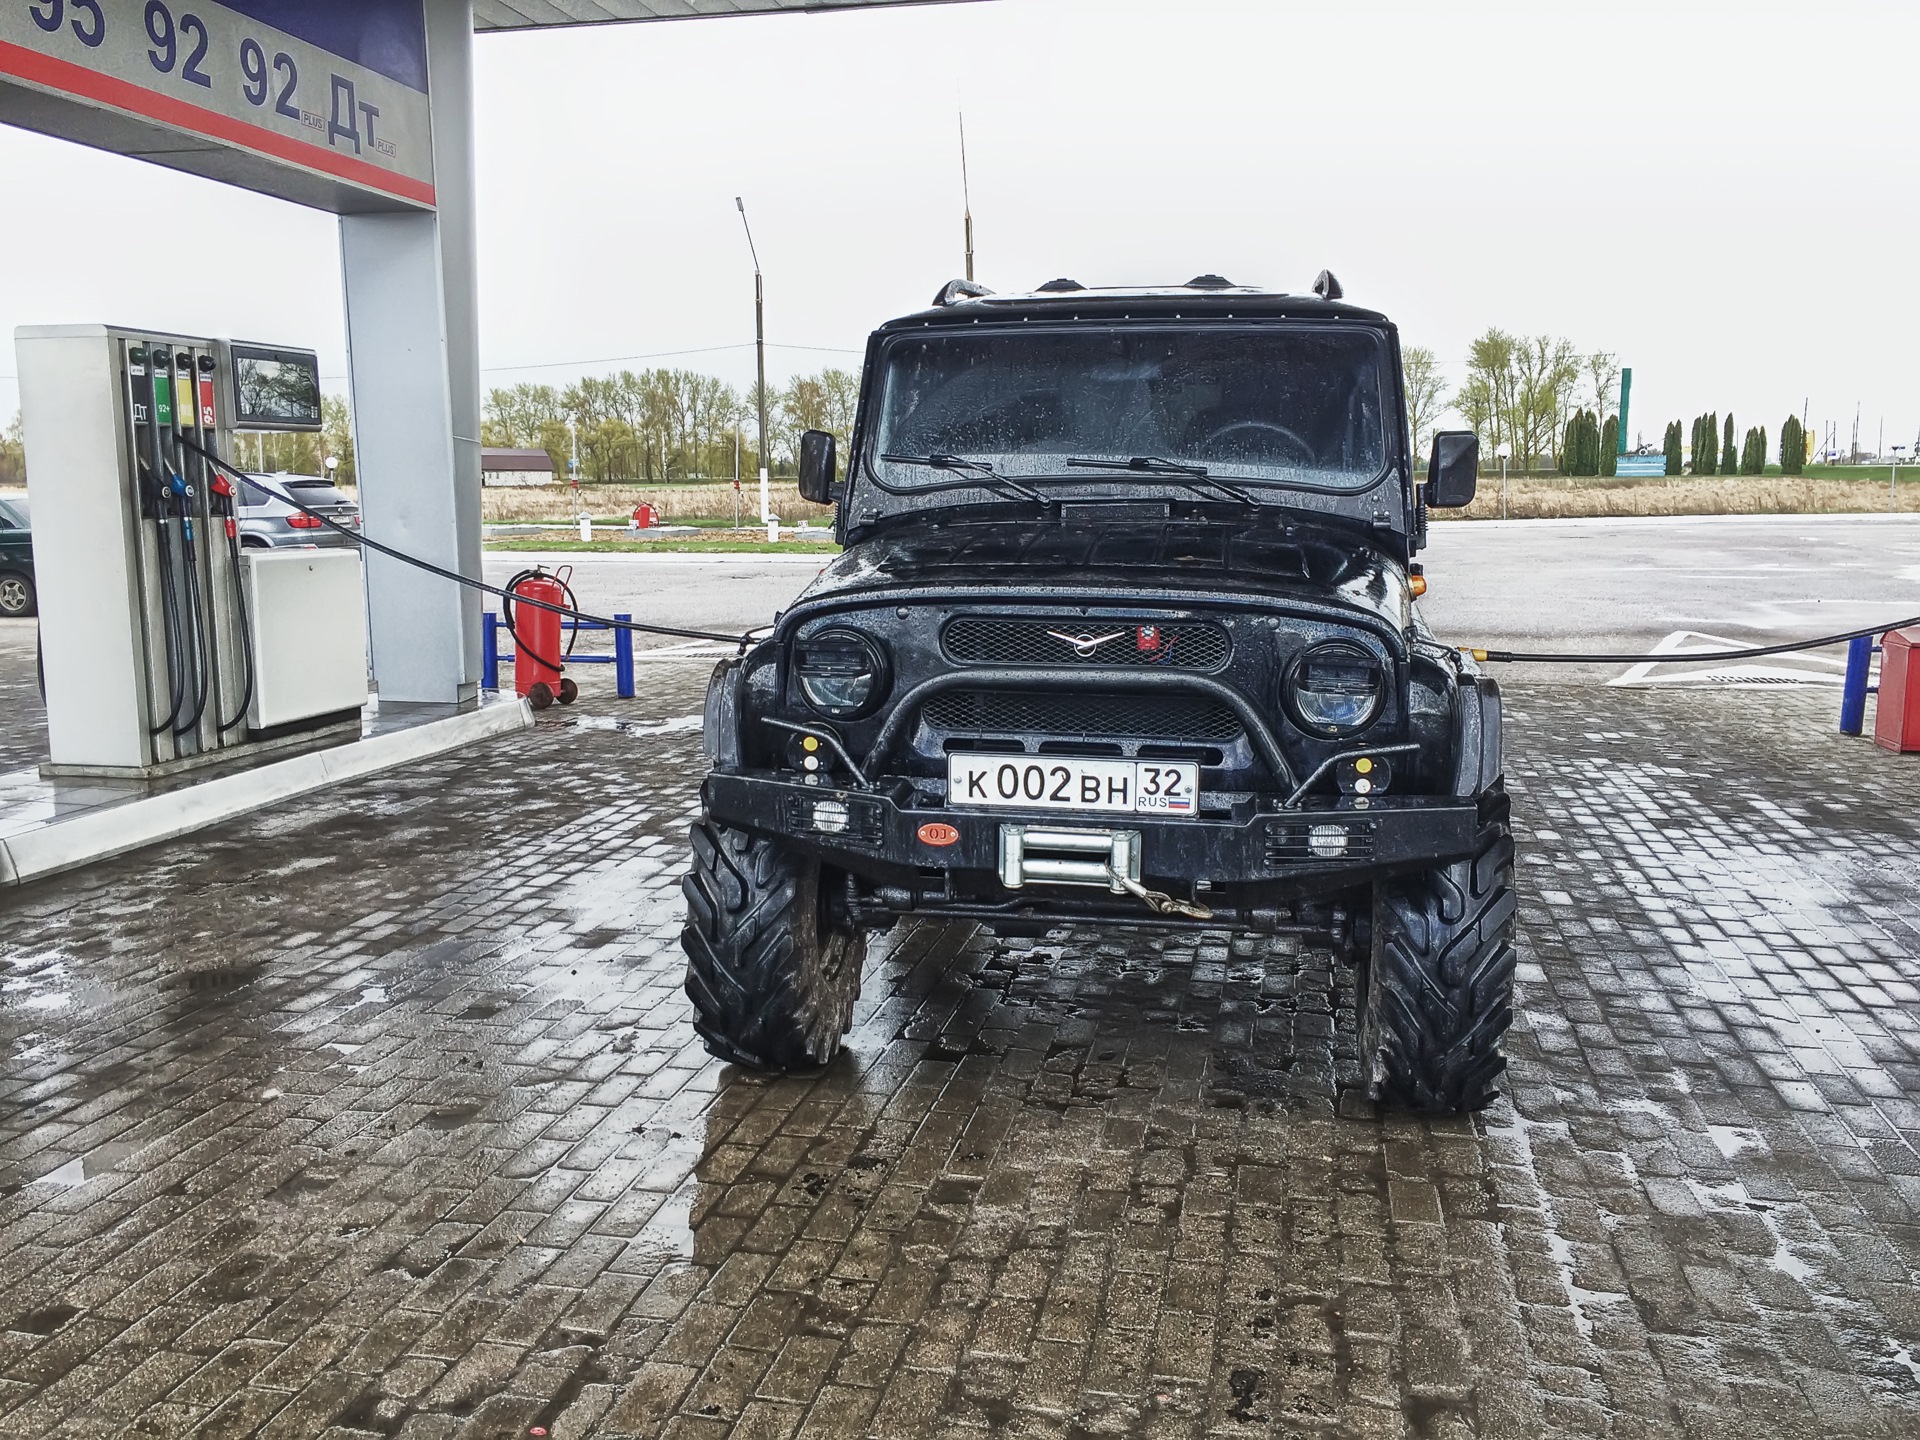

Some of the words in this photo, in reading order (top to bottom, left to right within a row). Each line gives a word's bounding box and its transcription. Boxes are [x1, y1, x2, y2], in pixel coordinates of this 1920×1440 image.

[144, 0, 212, 88] 92
[240, 38, 300, 120] 92
[303, 112, 324, 130] PLUS
[377, 140, 395, 156] PLUS
[158, 404, 171, 413] 92+
[203, 406, 214, 425] 95
[1143, 767, 1182, 797] 32
[1138, 796, 1168, 808] RUS
